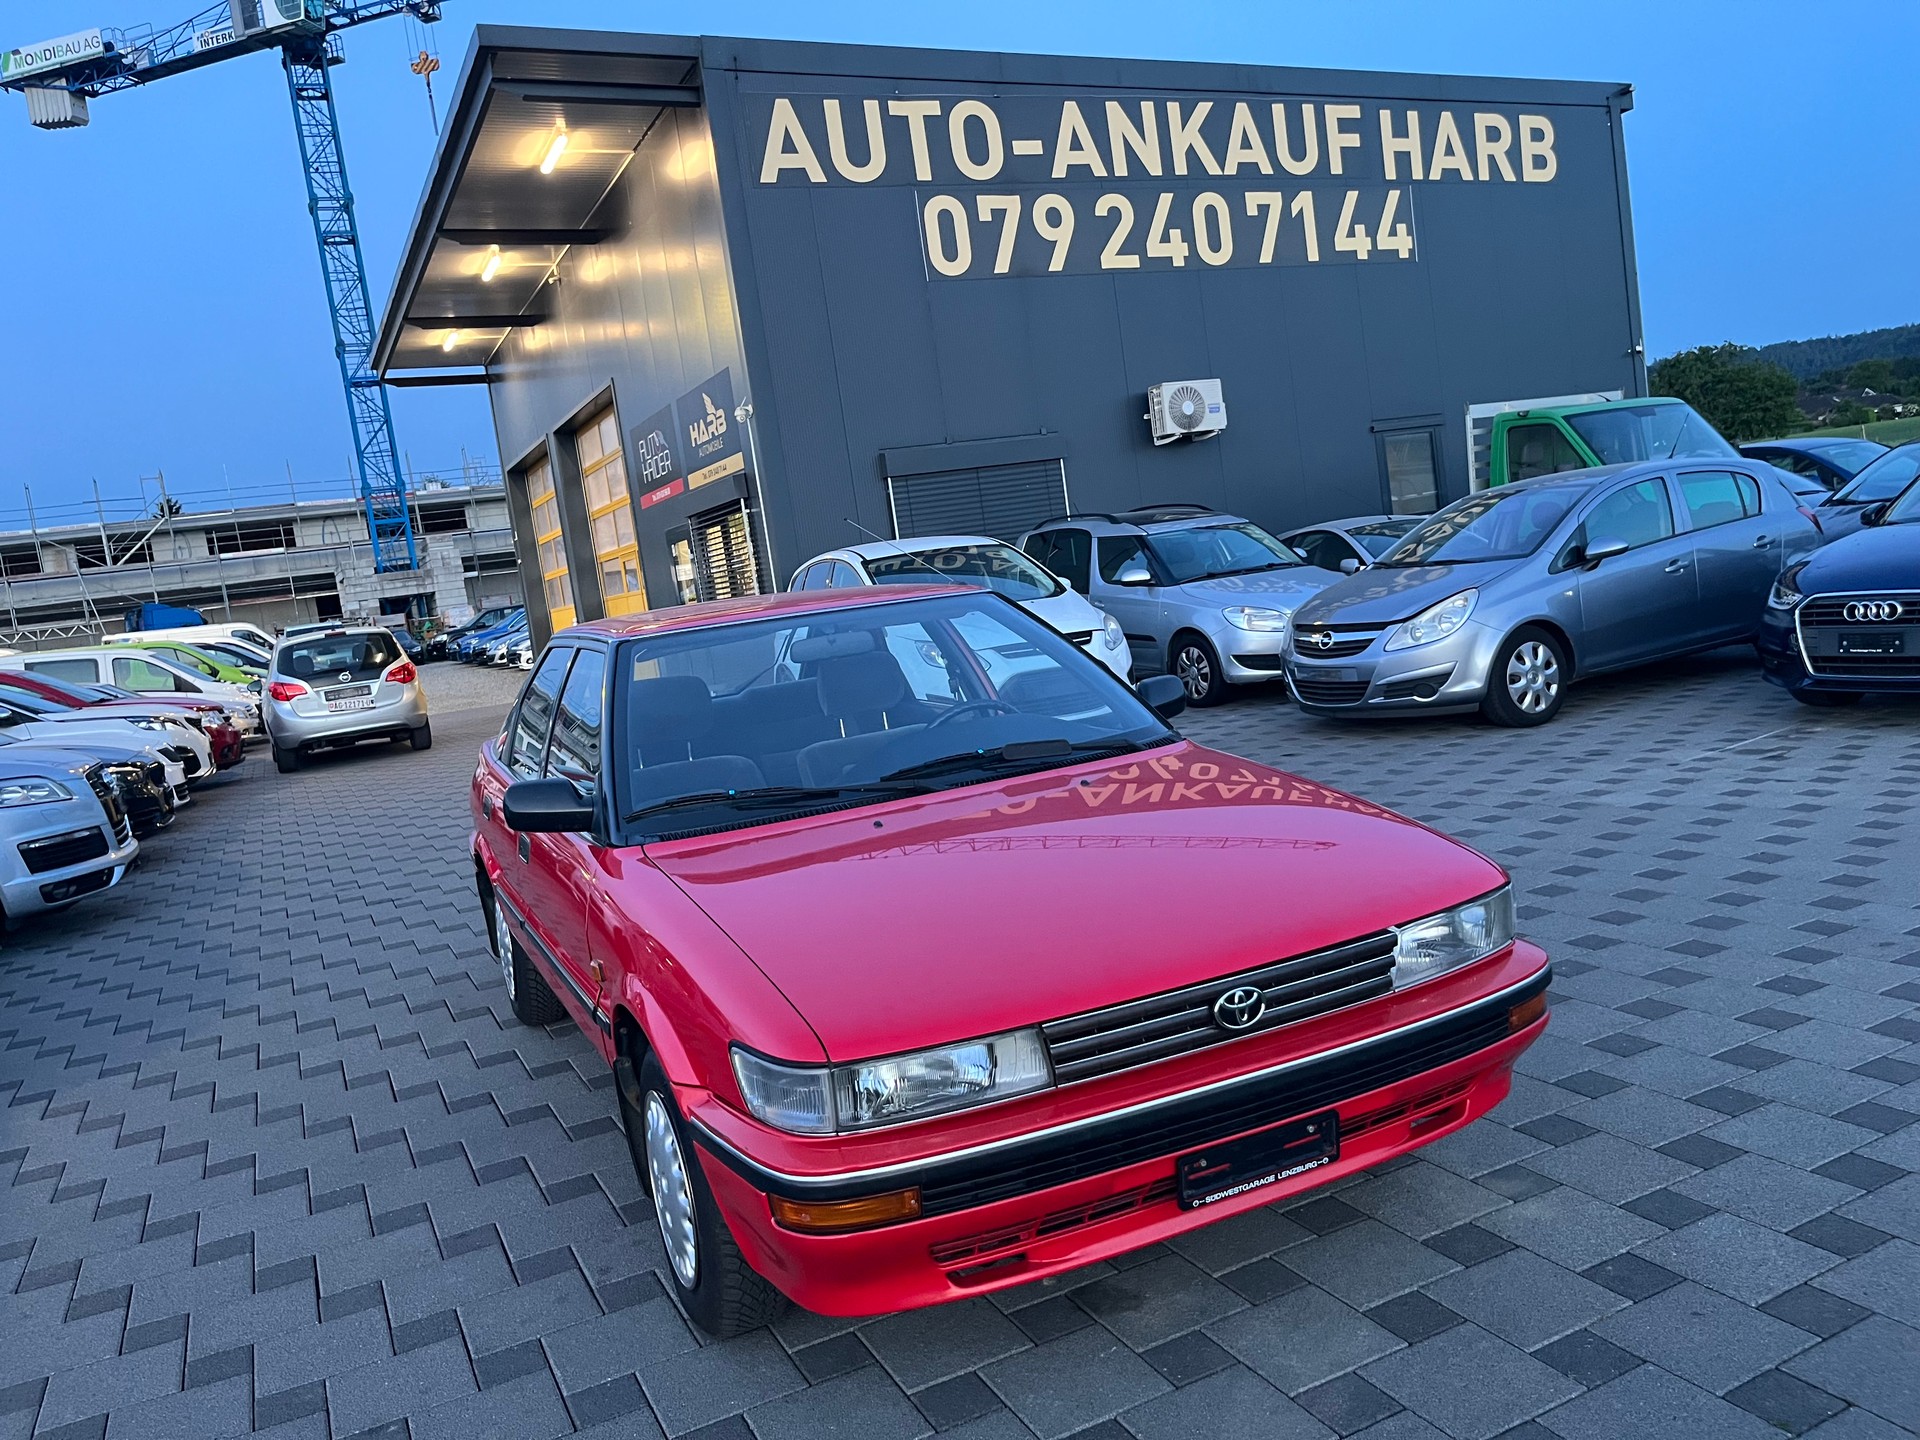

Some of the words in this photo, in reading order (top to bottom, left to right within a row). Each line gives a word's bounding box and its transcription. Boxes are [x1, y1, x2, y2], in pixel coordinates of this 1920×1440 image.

[14, 41, 81, 70] MONDIBAU
[84, 35, 101, 51] AG
[760, 98, 1361, 184] AUTO-ANKAUF
[1379, 109, 1558, 183] HARB
[924, 193, 1075, 277] 079
[1094, 191, 1233, 269] 240
[1244, 190, 1319, 264] 71
[1334, 189, 1413, 260] 44
[689, 408, 727, 448] HARB
[1205, 1174, 1276, 1204] SÜDWESTGARAGE
[1277, 1160, 1318, 1180] LENZBURG
